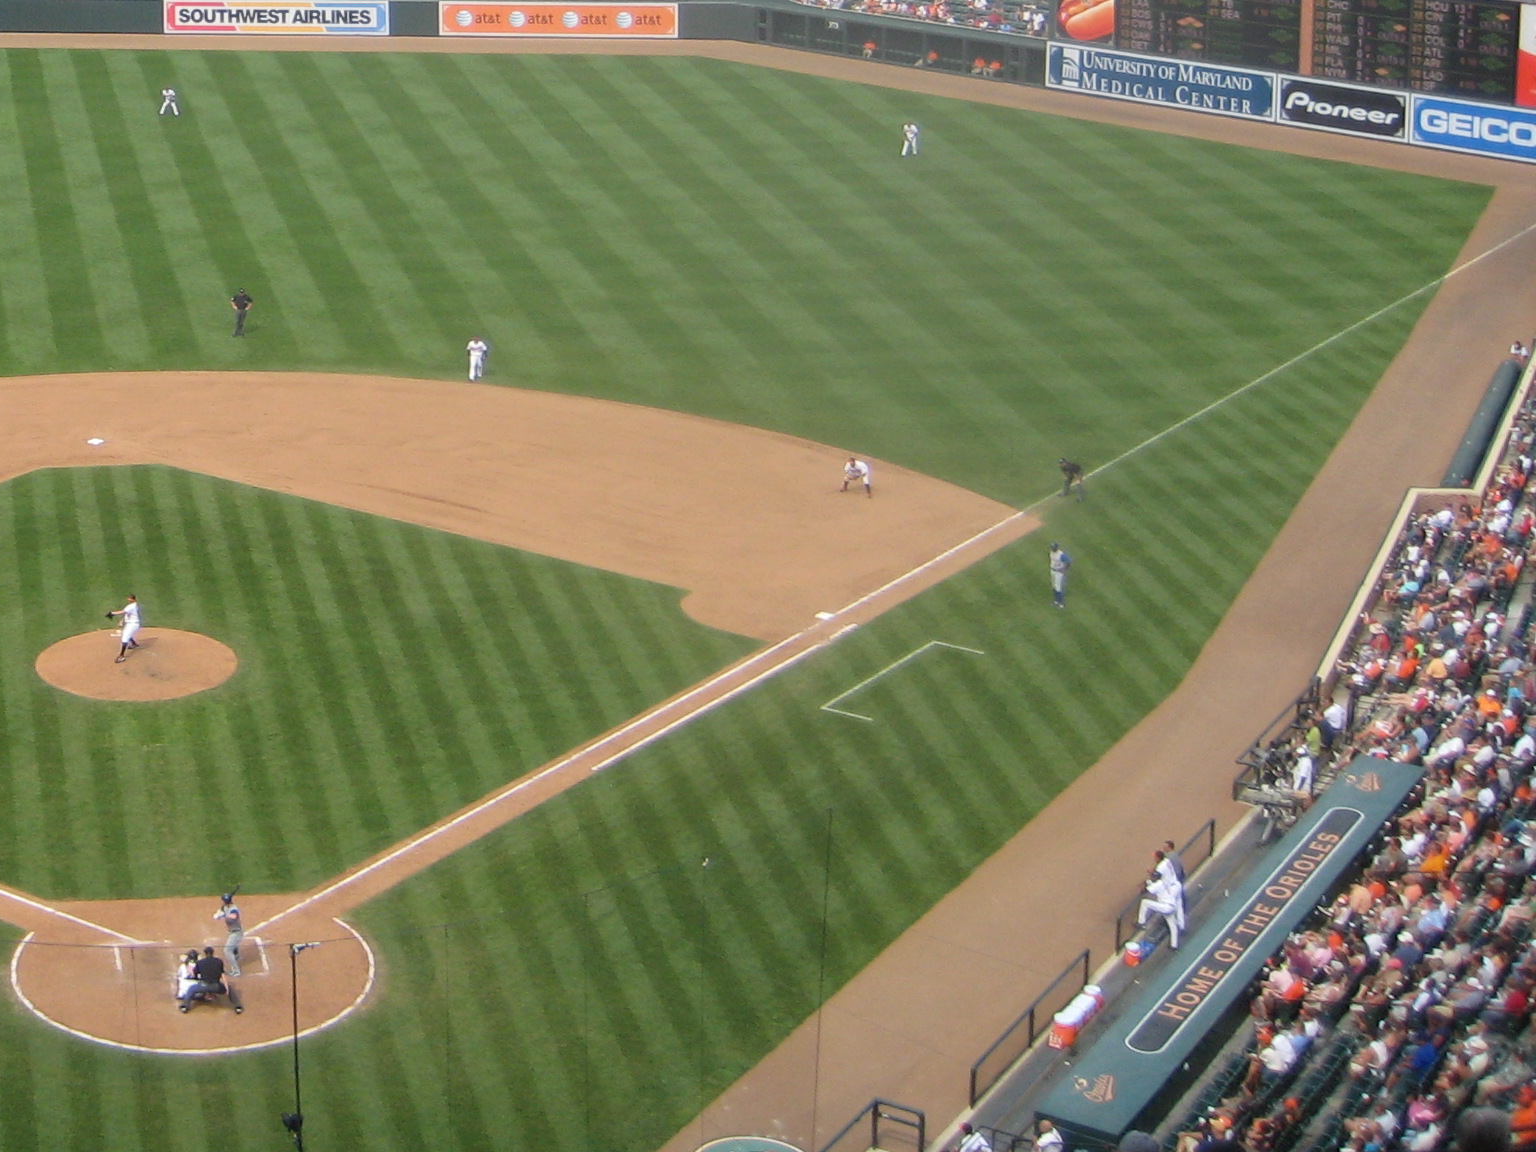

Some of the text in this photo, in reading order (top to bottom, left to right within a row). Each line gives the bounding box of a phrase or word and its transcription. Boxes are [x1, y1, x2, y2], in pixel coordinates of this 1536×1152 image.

[179, 9, 371, 25] SOUTHWEST AIRLINES
[475, 12, 661, 25] at&t at&t at&t at&t
[1083, 51, 1252, 91] UNIVERSITY OF MARYLAND
[1082, 72, 1251, 113] MEDICAL CENTER
[1285, 91, 1399, 125] Pioneer
[1420, 108, 1536, 147] GEICO
[1158, 832, 1340, 1020] HOME OF THE ORIOLES
